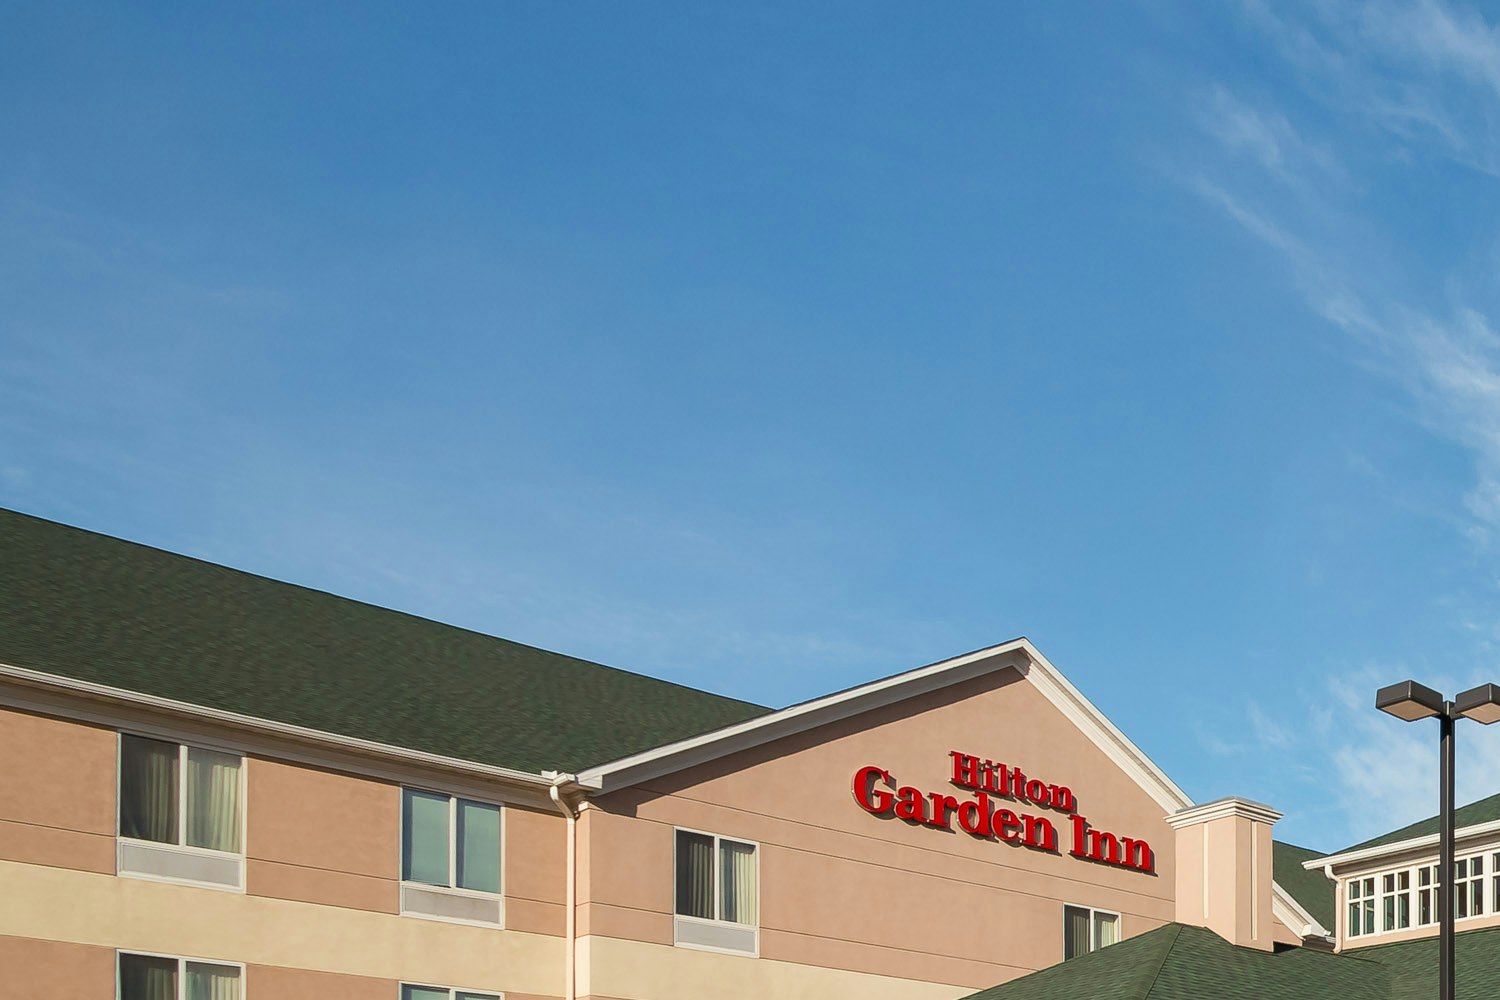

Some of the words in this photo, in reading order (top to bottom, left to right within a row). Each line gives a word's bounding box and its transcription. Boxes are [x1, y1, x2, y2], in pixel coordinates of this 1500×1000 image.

[853, 766, 1058, 851] Garden
[1068, 813, 1154, 872] Inn
[950, 751, 1076, 812] Hilton
